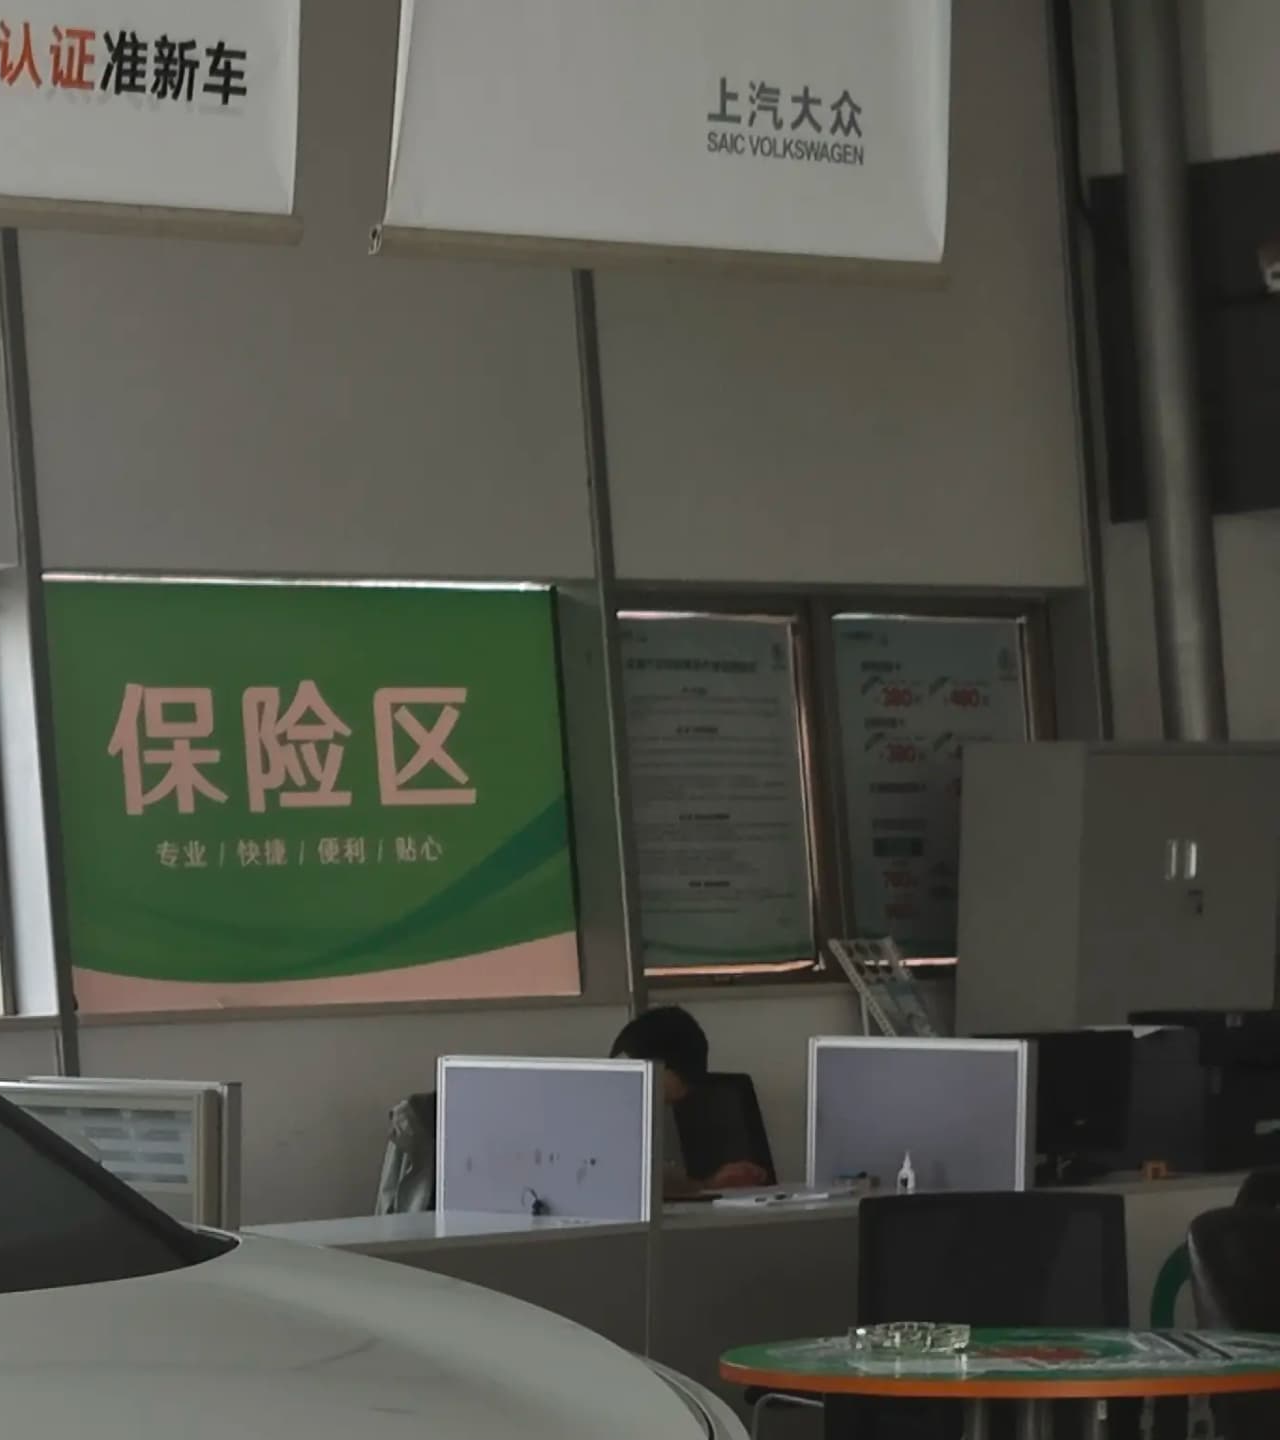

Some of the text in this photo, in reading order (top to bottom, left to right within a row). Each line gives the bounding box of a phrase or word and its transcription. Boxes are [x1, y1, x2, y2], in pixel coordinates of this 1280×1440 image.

[707, 77, 862, 138] 上汽大众
[707, 131, 864, 165] SAIC VOLKSWAGEN
[107, 679, 477, 815] 保险区
